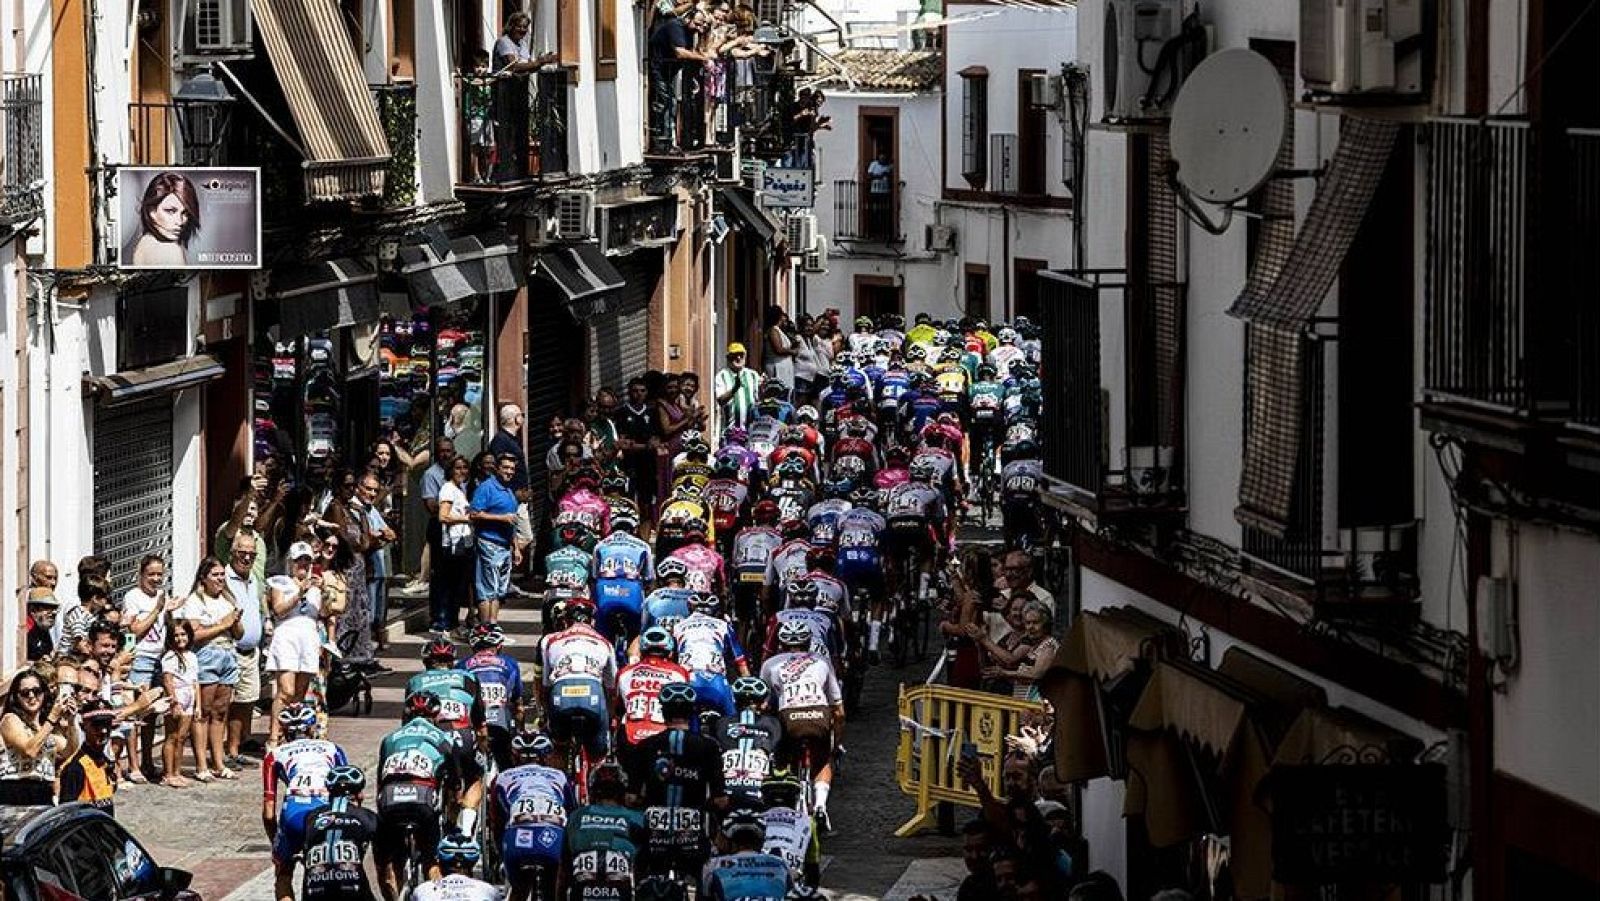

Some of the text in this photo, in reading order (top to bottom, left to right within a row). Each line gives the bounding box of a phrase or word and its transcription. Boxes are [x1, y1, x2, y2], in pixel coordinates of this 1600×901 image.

[443, 702, 461, 714] 48
[296, 774, 312, 787] 74
[518, 799, 562, 815] 73 73
[582, 814, 628, 826] BORA
[582, 887, 620, 897] BORA
